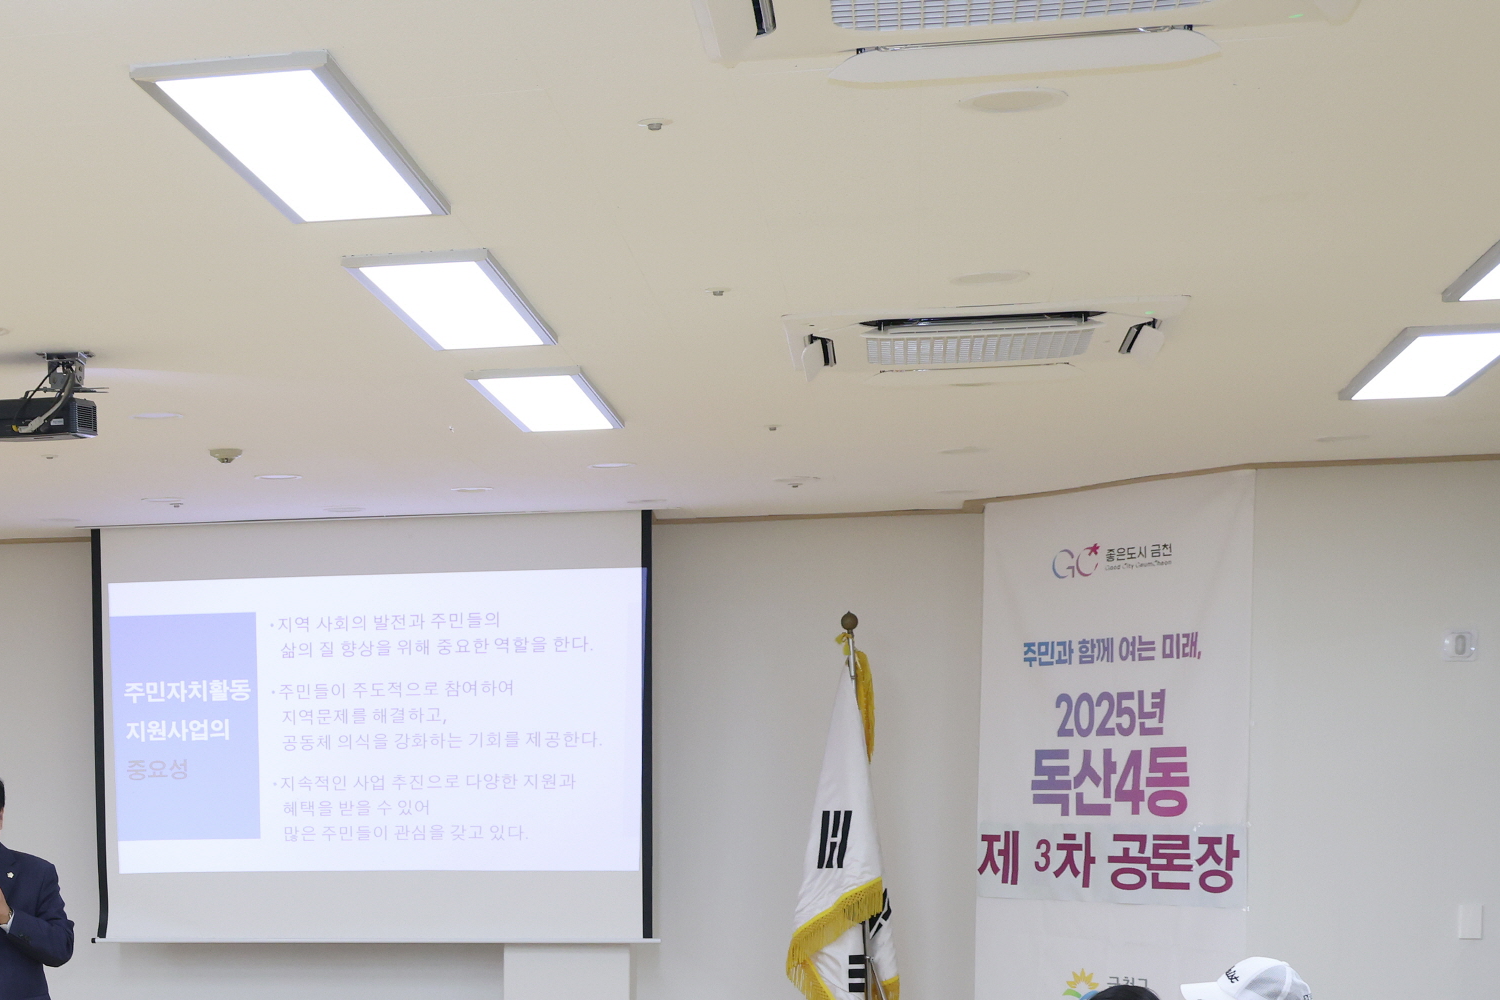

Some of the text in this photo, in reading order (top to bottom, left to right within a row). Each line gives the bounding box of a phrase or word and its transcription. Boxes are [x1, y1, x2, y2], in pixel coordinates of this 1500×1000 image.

[1106, 543, 1173, 562] 좋은도시 금천
[278, 611, 499, 633] 지역 사회의 발전과 주민들의
[281, 636, 593, 658] 삶의 질 향상을 위해 중요한 역할을 한다.
[1023, 631, 1202, 667] 주민과 함께 여는 미래,
[123, 678, 251, 703] 주민자치활동
[279, 679, 513, 700] 주민들이 주도적으로 참여하여
[282, 707, 447, 725] 지역문제를 해결하고,
[1055, 688, 1166, 737] 2025년
[126, 718, 230, 742] 지원사업의
[282, 731, 602, 751] 공동체 의식을 강화하는 기회를 제공한다.
[127, 759, 188, 781] 중요성
[281, 773, 576, 791] 지속적인 사업 추진으로 다양한 지원과
[1031, 746, 1190, 818] 독산4동
[283, 800, 429, 817] 혜택을 받을 수 있어
[284, 824, 528, 842] 많은 주민들이 관심을 갖고 있다.
[978, 829, 1240, 894] 제 3차 공론장
